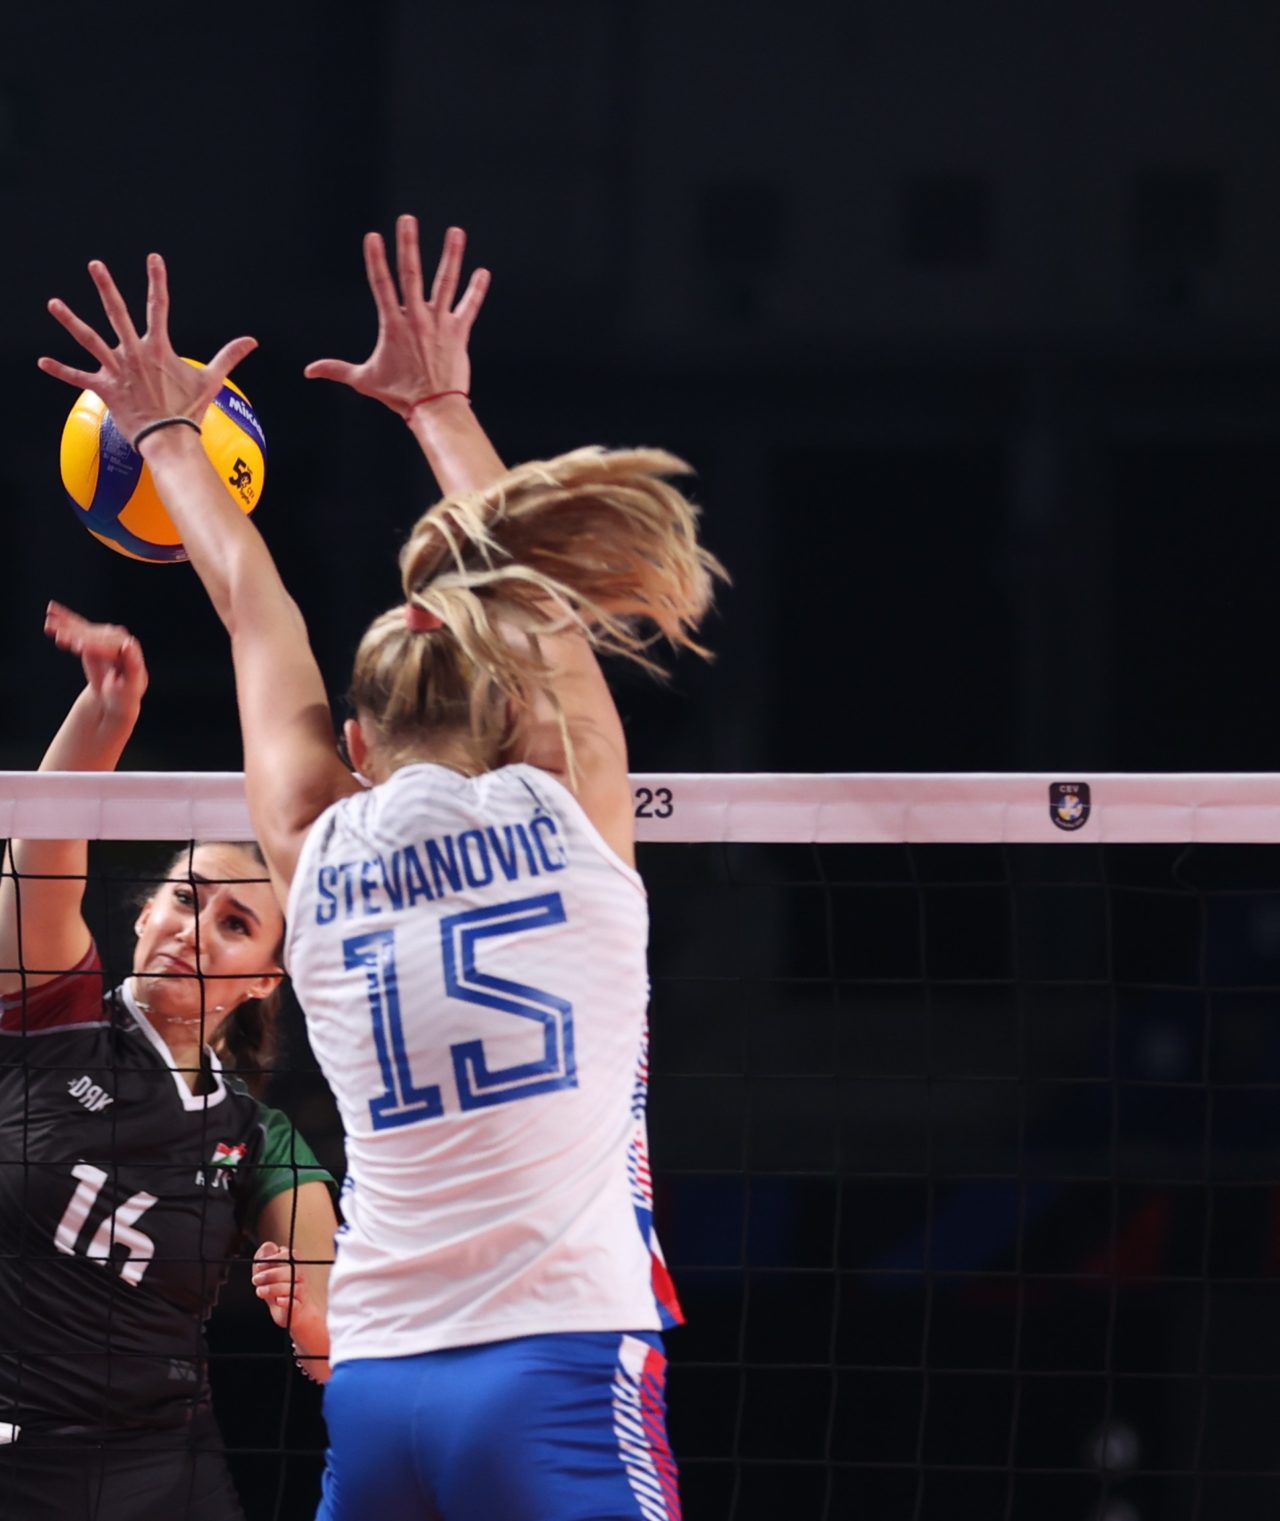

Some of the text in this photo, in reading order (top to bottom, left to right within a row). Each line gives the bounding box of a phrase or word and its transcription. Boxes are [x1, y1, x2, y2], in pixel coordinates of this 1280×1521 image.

[315, 807, 567, 926] STEVANOVIĆ
[342, 891, 579, 1131] 15
[53, 1159, 159, 1287] 16
